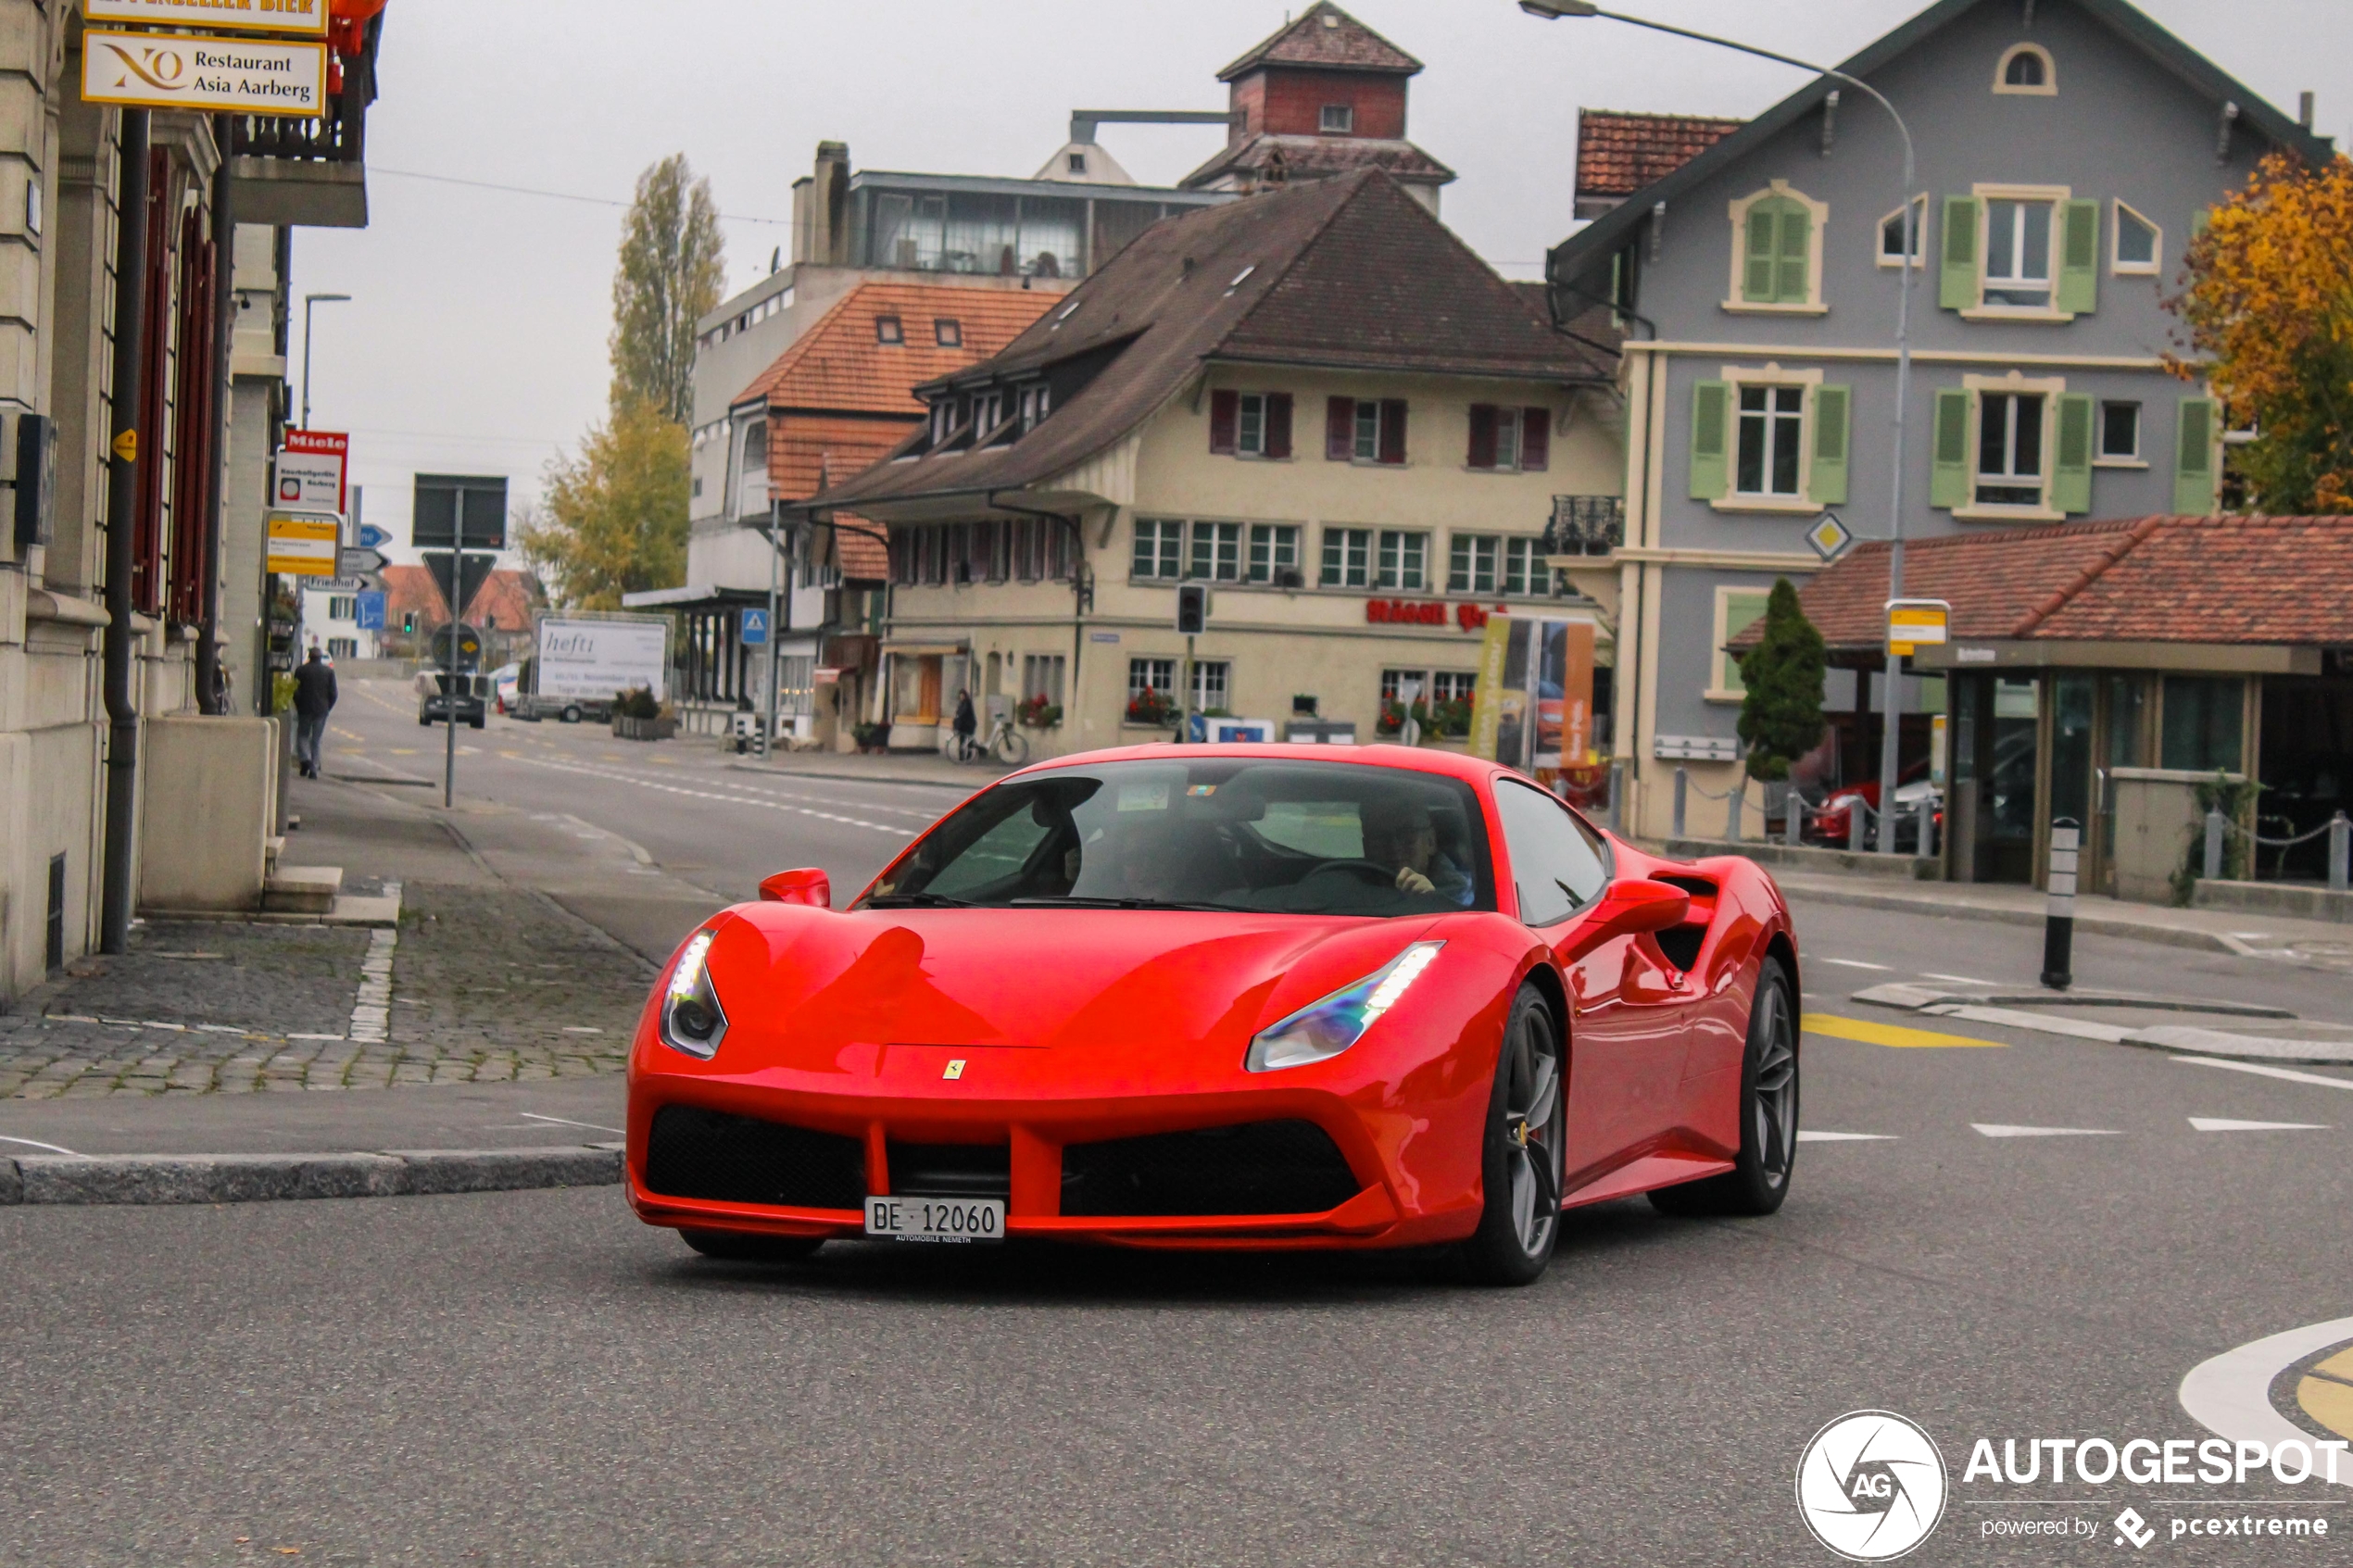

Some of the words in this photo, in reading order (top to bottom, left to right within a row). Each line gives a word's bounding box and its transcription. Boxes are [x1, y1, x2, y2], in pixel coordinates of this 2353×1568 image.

[195, 51, 292, 72] Restaurant
[193, 76, 232, 93] Asia
[237, 78, 311, 102] Aarberg
[289, 434, 346, 450] Miele
[310, 575, 355, 587] Friedhof
[547, 632, 593, 654] hefti
[874, 1202, 903, 1231] BE
[923, 1204, 995, 1233] 12060
[895, 1235, 940, 1243] AUTOMOBILE
